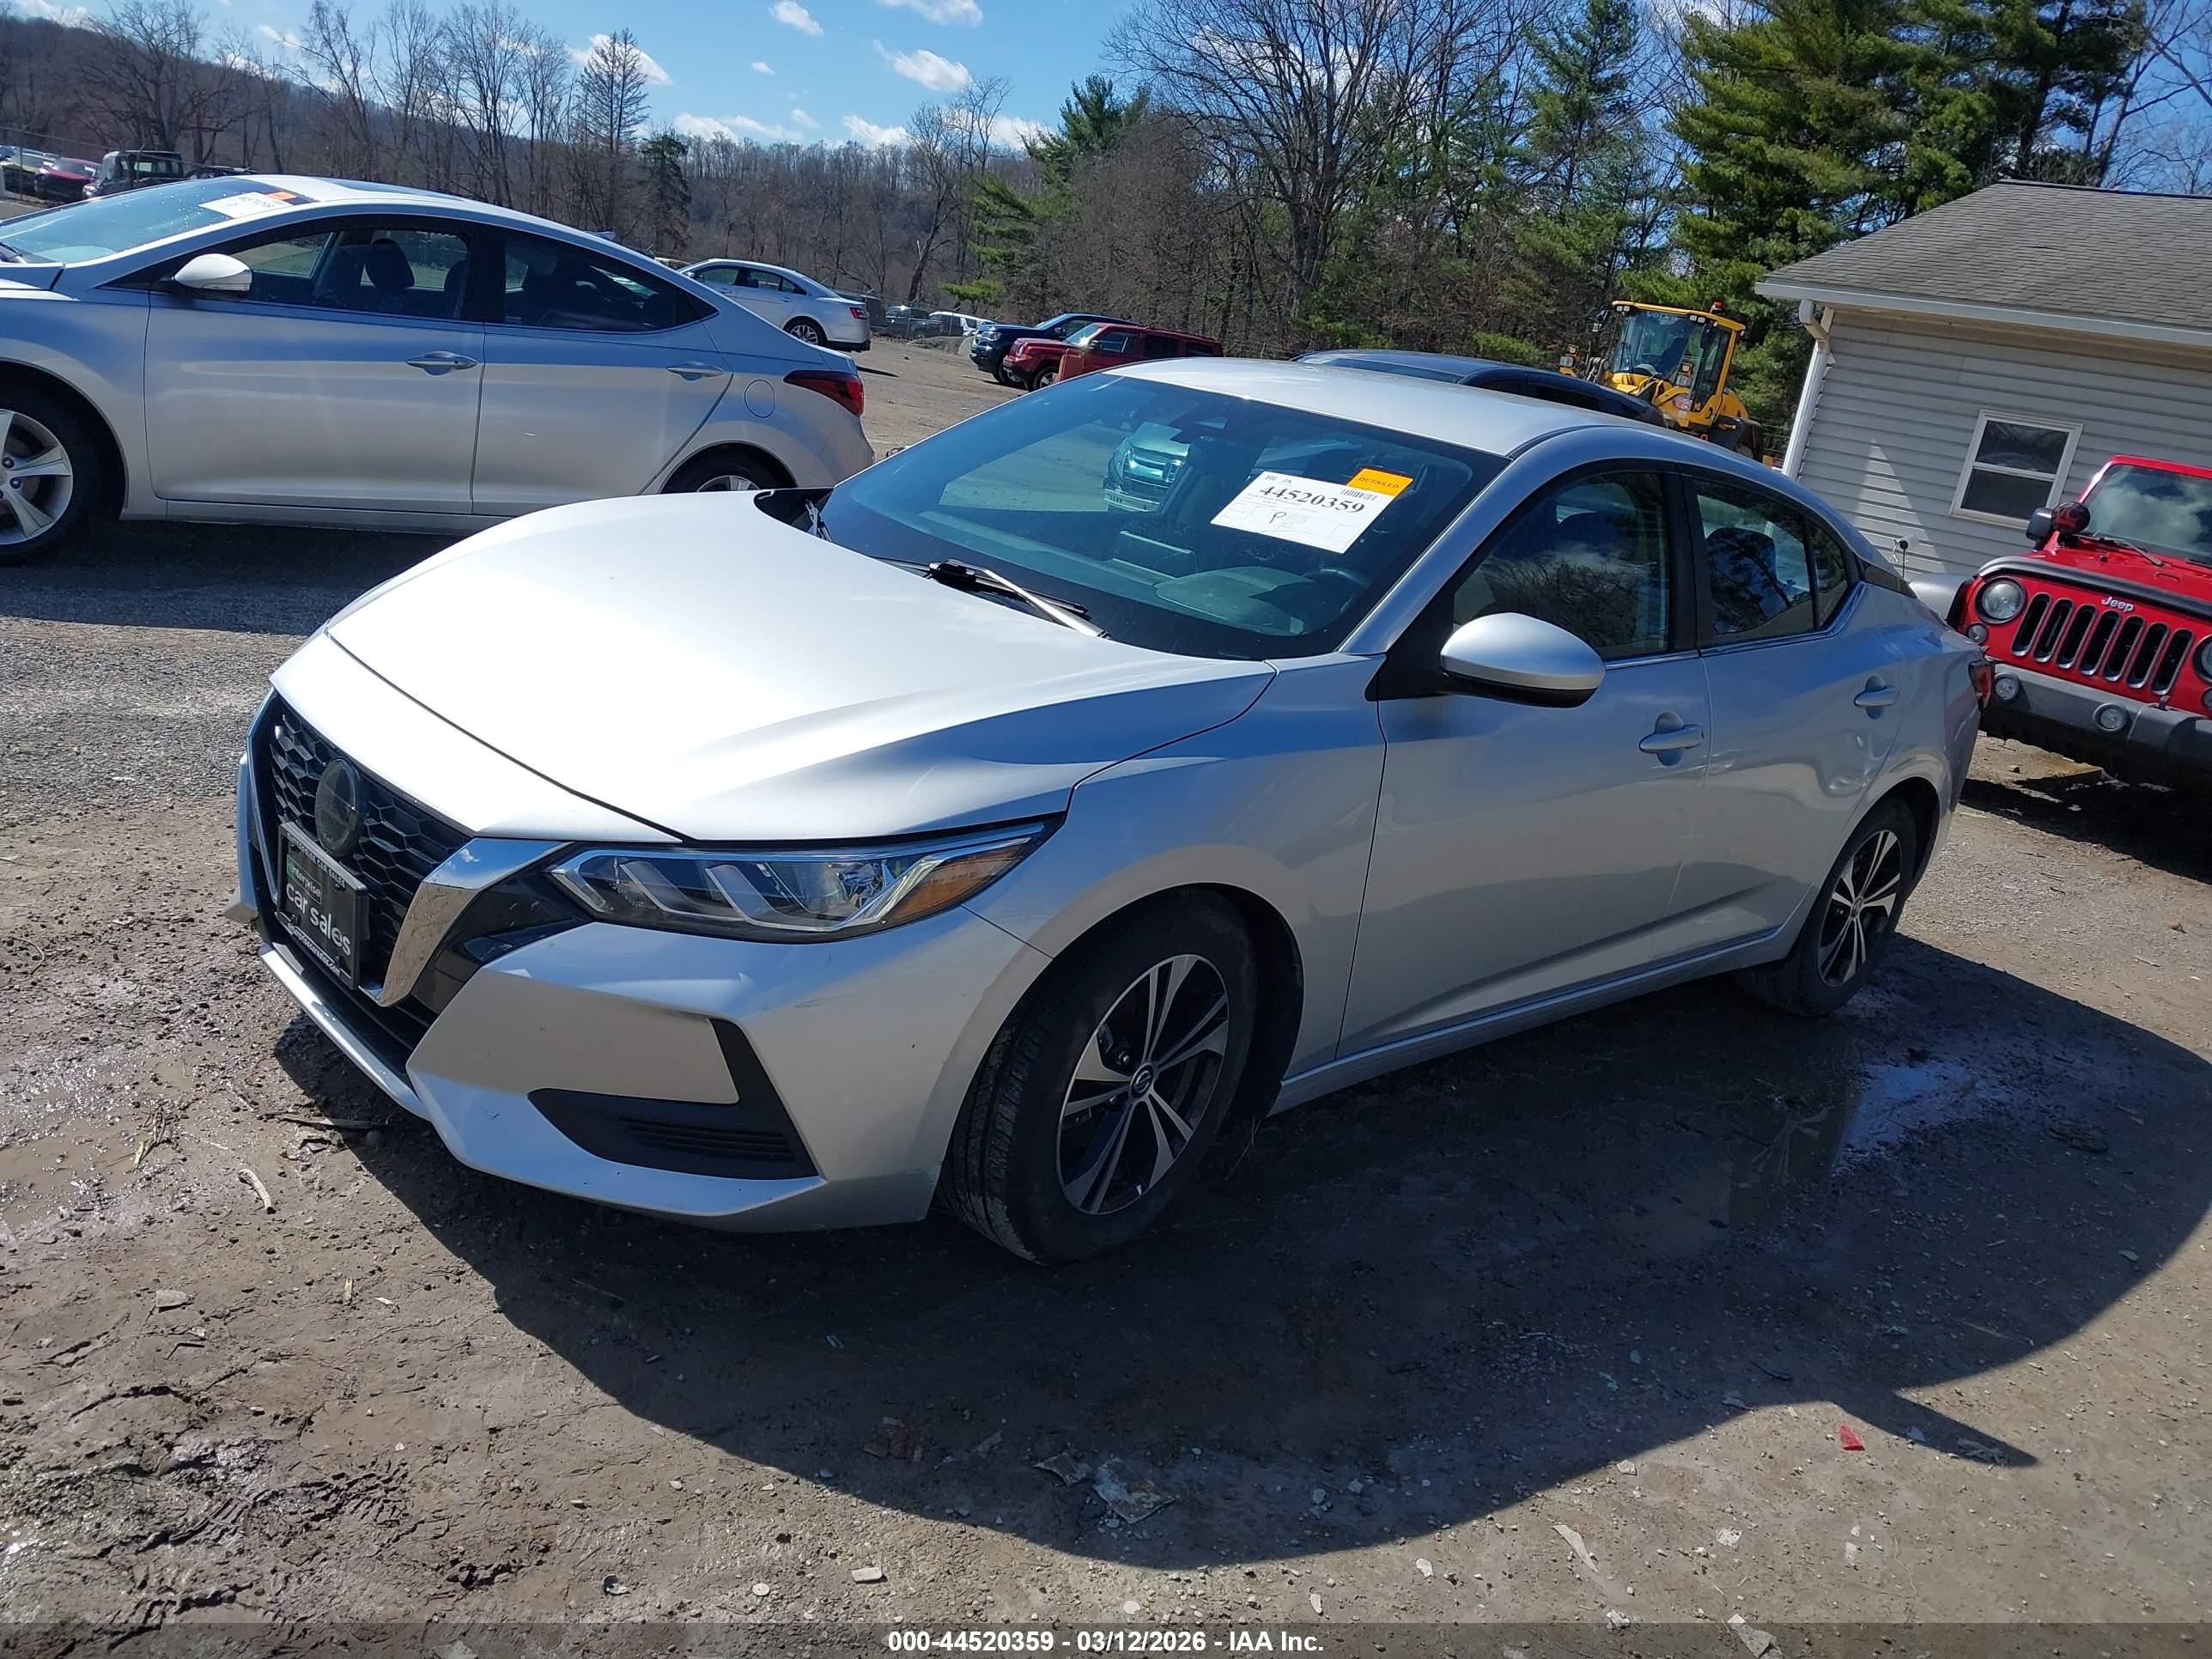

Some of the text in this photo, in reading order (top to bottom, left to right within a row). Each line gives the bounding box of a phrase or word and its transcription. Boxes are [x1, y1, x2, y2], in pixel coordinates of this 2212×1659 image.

[1358, 476, 1401, 489] DETAILED
[1260, 485, 1366, 514] 44520359
[2101, 596, 2134, 612] Jeep
[287, 861, 322, 898] enterprise
[286, 882, 351, 956] car sales
